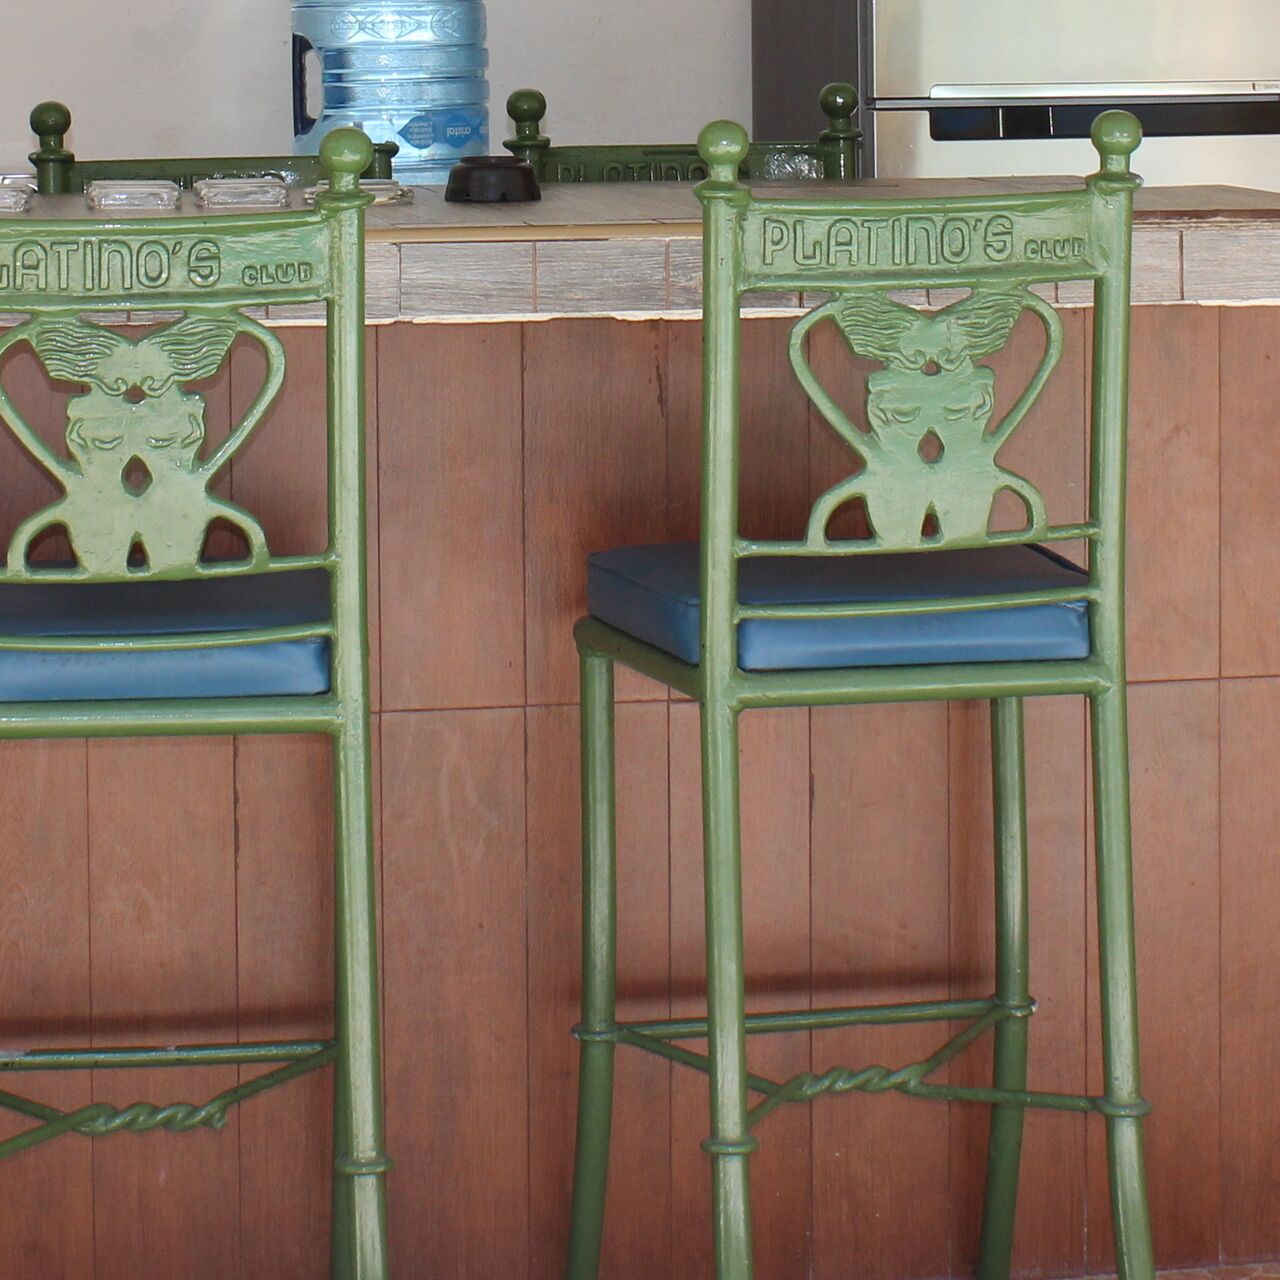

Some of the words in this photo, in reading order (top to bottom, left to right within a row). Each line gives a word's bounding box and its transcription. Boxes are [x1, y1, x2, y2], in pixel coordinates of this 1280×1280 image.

[763, 214, 1014, 266] PLATINO'S
[1024, 237, 1084, 260] CLUB
[241, 261, 313, 287] CLUB
